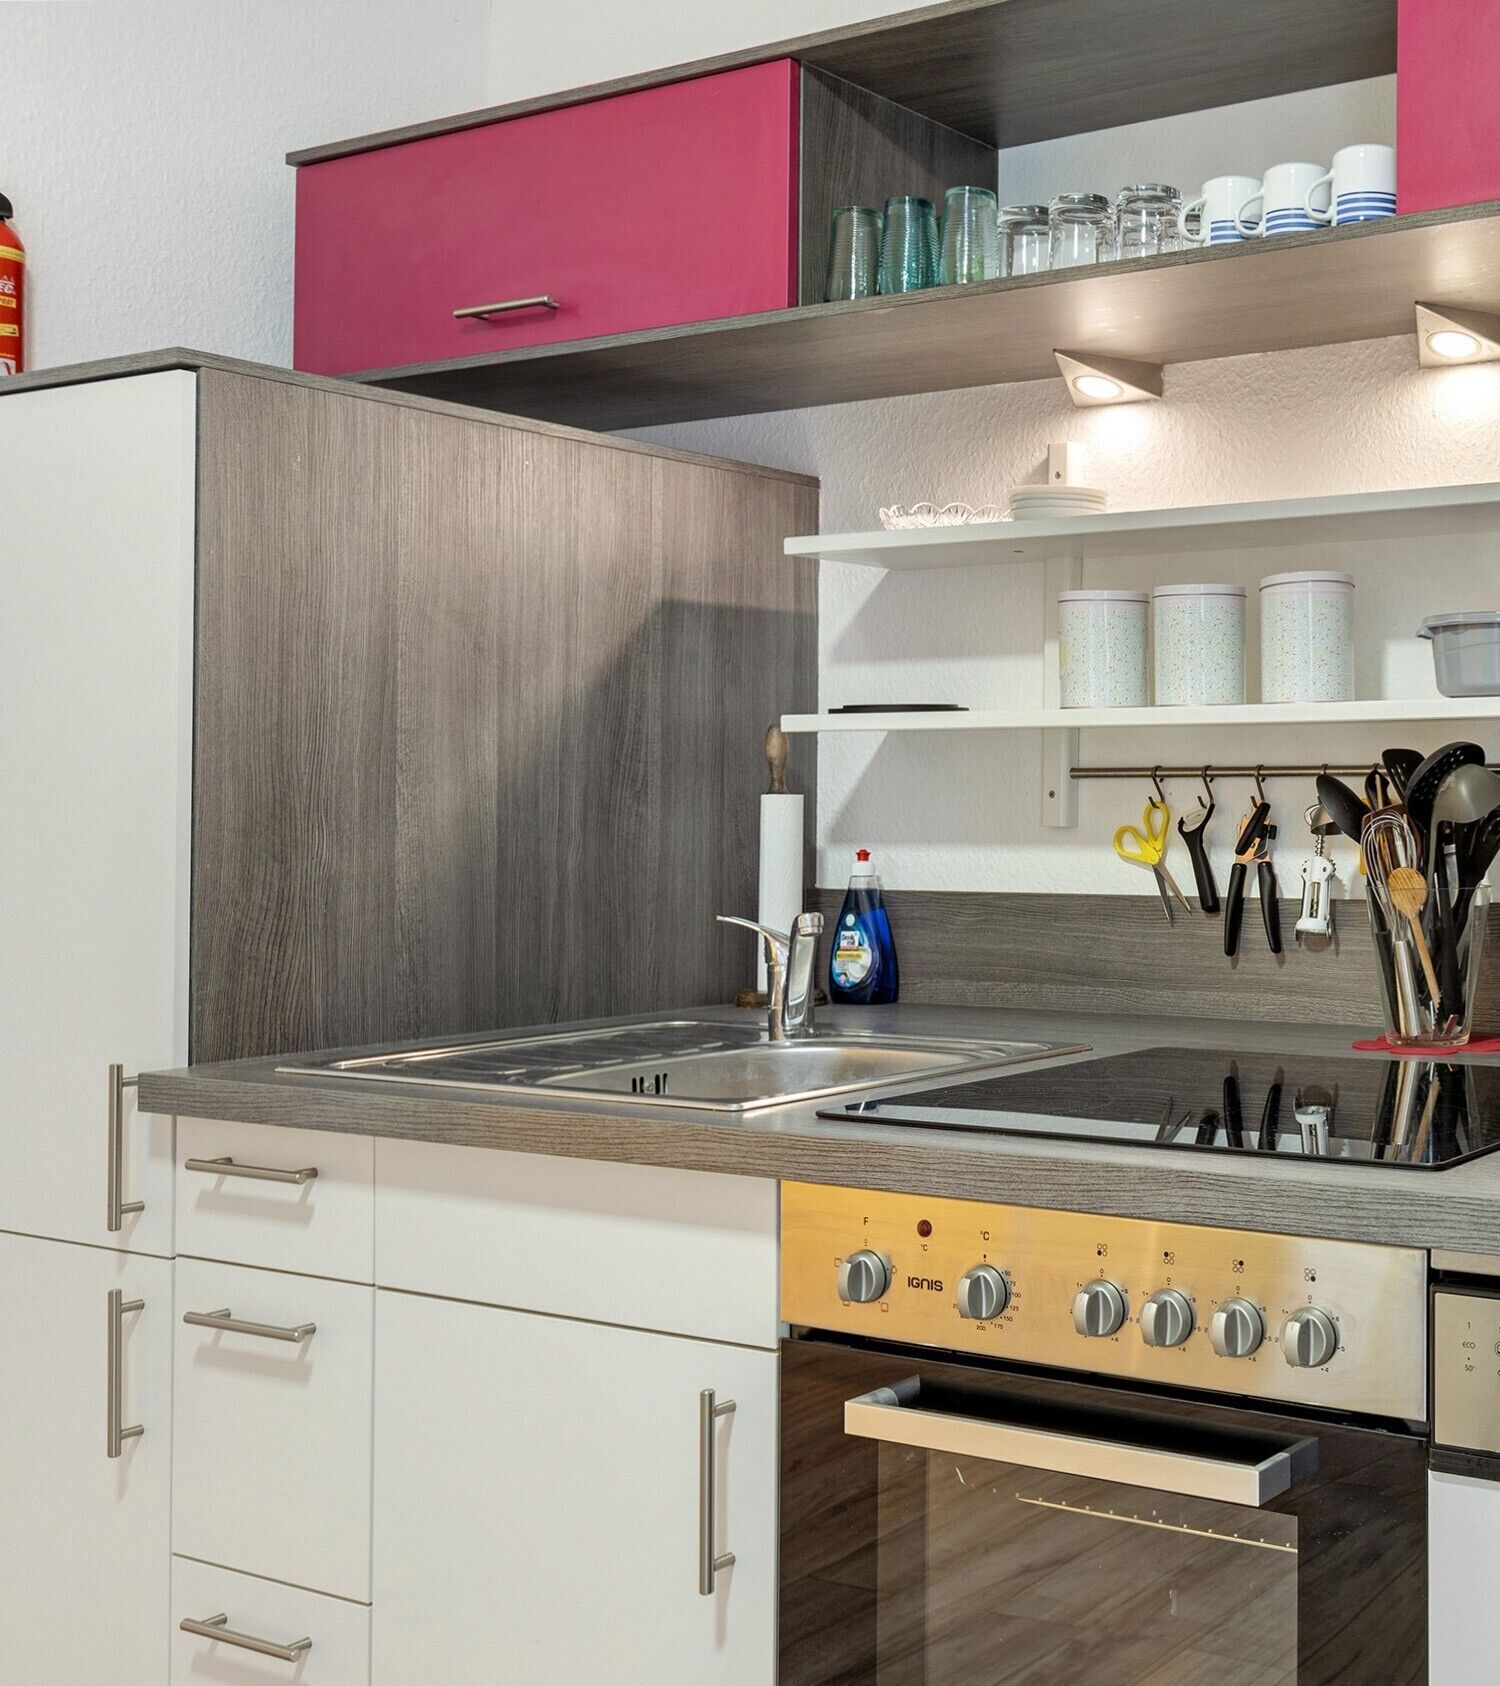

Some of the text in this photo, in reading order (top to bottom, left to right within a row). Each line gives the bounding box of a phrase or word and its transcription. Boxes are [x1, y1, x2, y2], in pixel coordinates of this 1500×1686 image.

[863, 1216, 869, 1226] F
[907, 1276, 943, 1292] IGNIS
[1011, 1291, 1022, 1299] 100
[976, 1324, 987, 1332] 200
